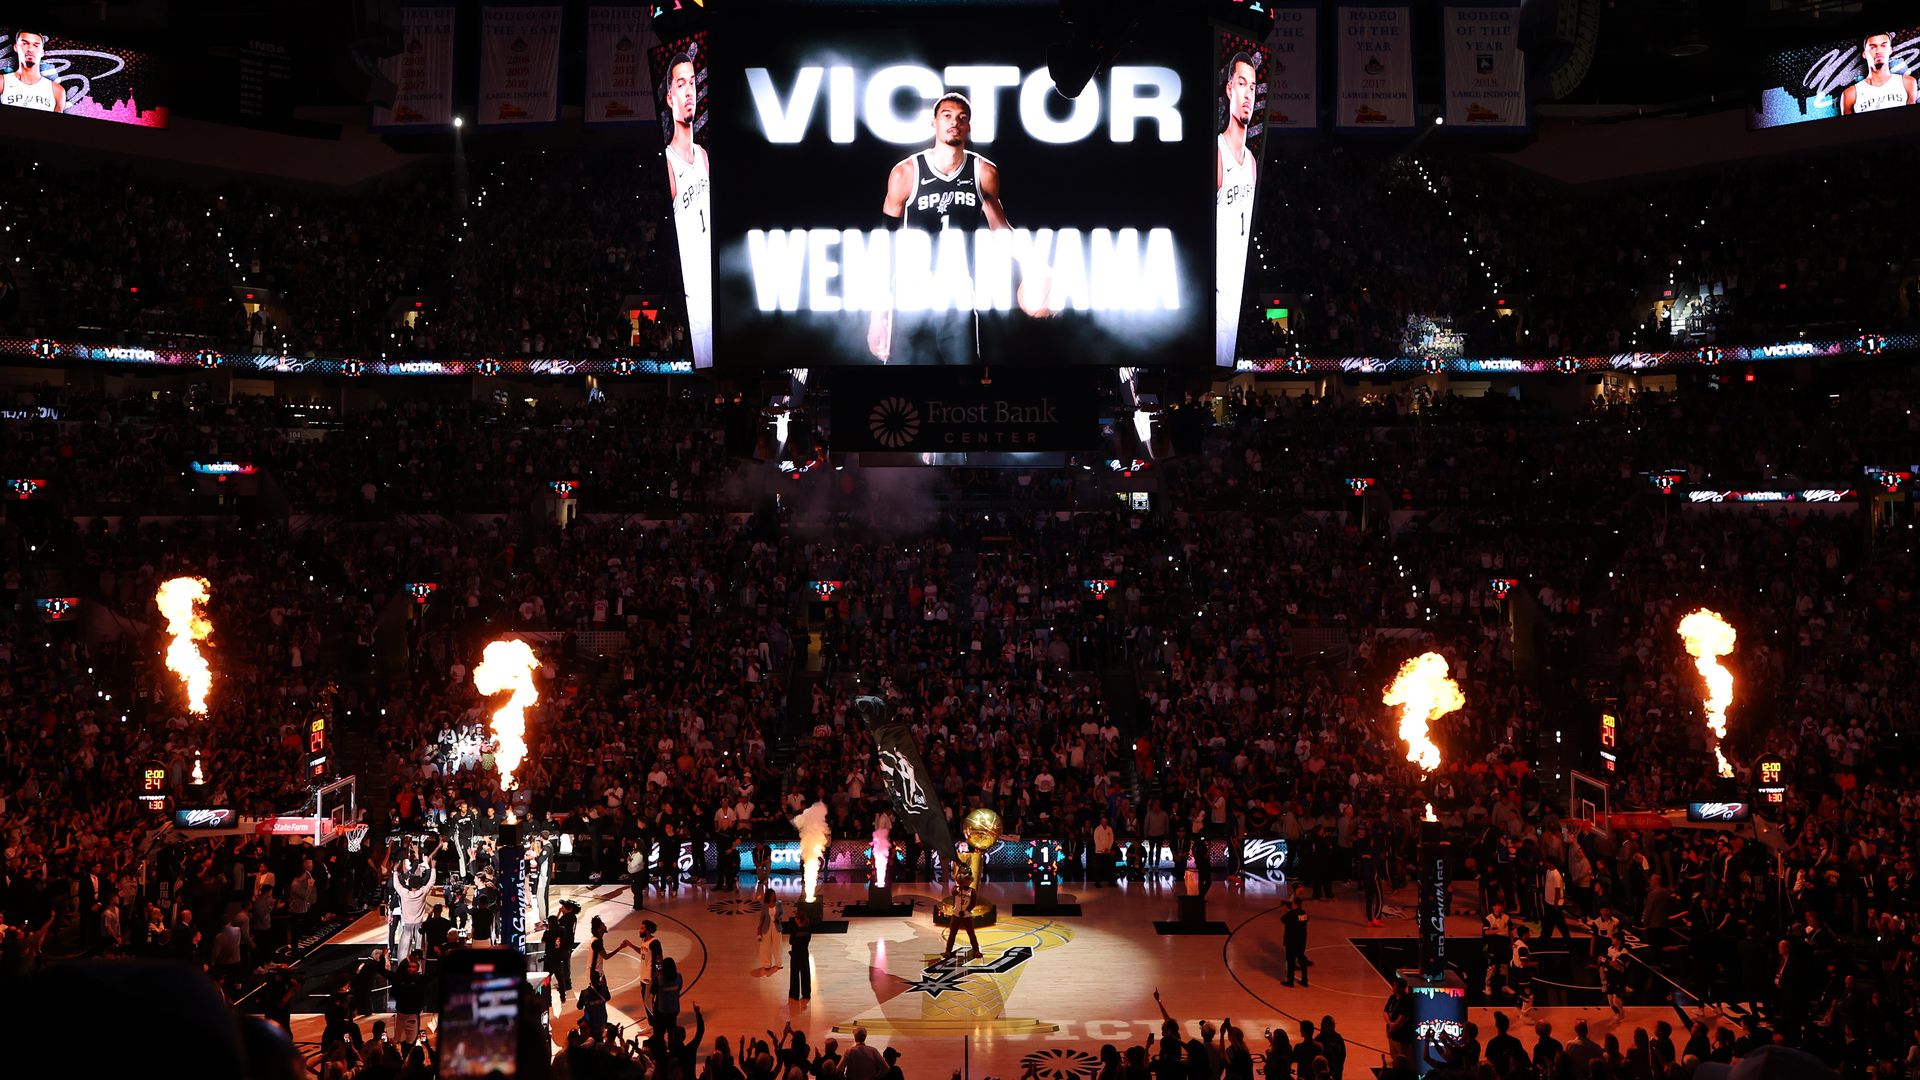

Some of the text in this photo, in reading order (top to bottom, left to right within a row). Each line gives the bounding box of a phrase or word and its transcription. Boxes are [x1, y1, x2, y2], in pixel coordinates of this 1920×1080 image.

[1350, 11, 1397, 20] RODEO
[1458, 11, 1510, 21] RODEO
[1348, 26, 1400, 36] OF THE
[1457, 26, 1511, 36] OF THE
[1357, 41, 1392, 51] YEAR
[1466, 41, 1504, 51] YEAR
[1363, 79, 1385, 89] 2017
[744, 65, 1184, 144] VICTOR
[918, 191, 976, 214] SPURS
[746, 227, 1181, 312] WEMBANYAMA
[43, 344, 49, 355] 1
[1868, 338, 1874, 350] 1
[104, 347, 156, 360] VICTOR
[1763, 344, 1814, 357] VICTOR
[399, 362, 442, 373] VICTOR
[670, 361, 692, 372] VIC
[1478, 359, 1522, 370] VICTOR
[927, 396, 1058, 424] Frost Bank
[944, 431, 1040, 444] CENTER
[208, 463, 239, 472] VICTOR
[1748, 492, 1782, 500] VICTOR
[311, 731, 324, 752] 24
[1602, 725, 1615, 747] 24
[1761, 763, 1781, 772] 12:00
[145, 770, 165, 779] 12:00
[1763, 772, 1778, 782] 24
[145, 779, 161, 790] 24
[1768, 794, 1783, 802] 1:30
[148, 801, 163, 810] 1:30
[1041, 846, 1049, 863] 1
